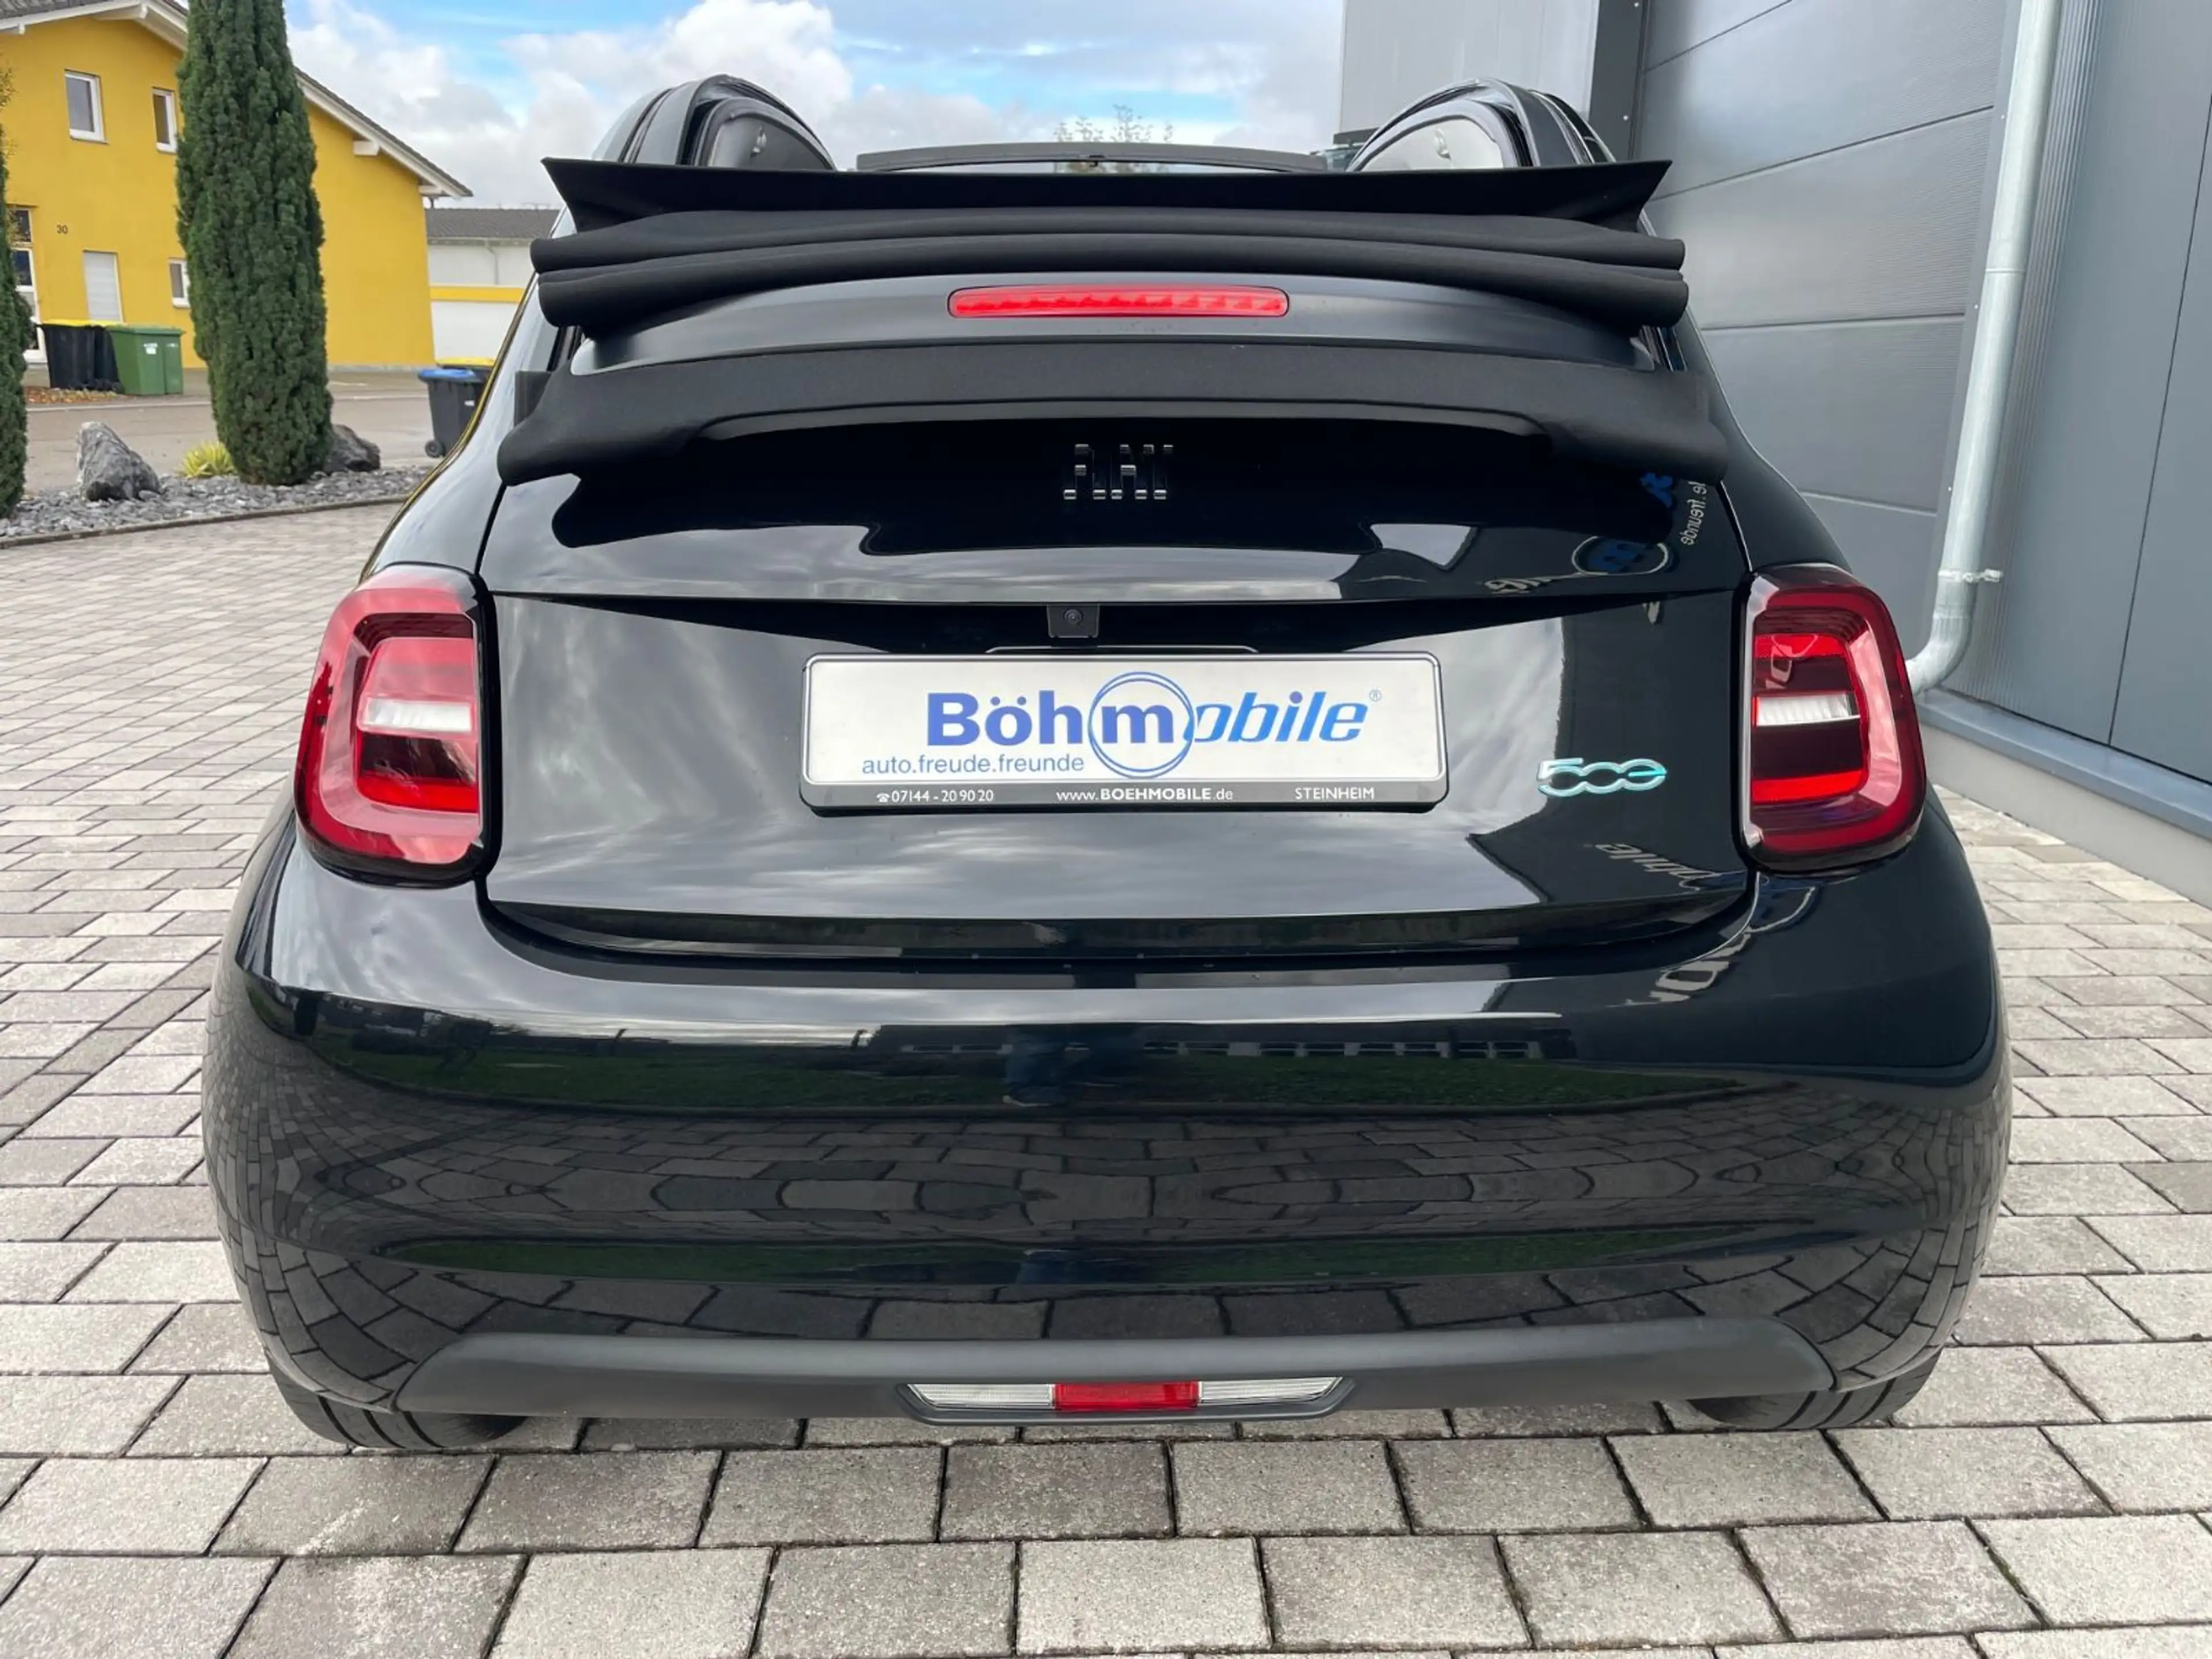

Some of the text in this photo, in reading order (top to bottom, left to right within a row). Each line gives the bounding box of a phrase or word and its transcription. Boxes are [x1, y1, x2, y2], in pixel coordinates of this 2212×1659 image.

[56, 224, 69, 234] 30
[862, 753, 1085, 774] auto.freude.freunde
[891, 789, 930, 802] 07144
[1056, 787, 1234, 801] www.BOEHMOBILE.de
[1294, 786, 1376, 801] STEINHEIM
